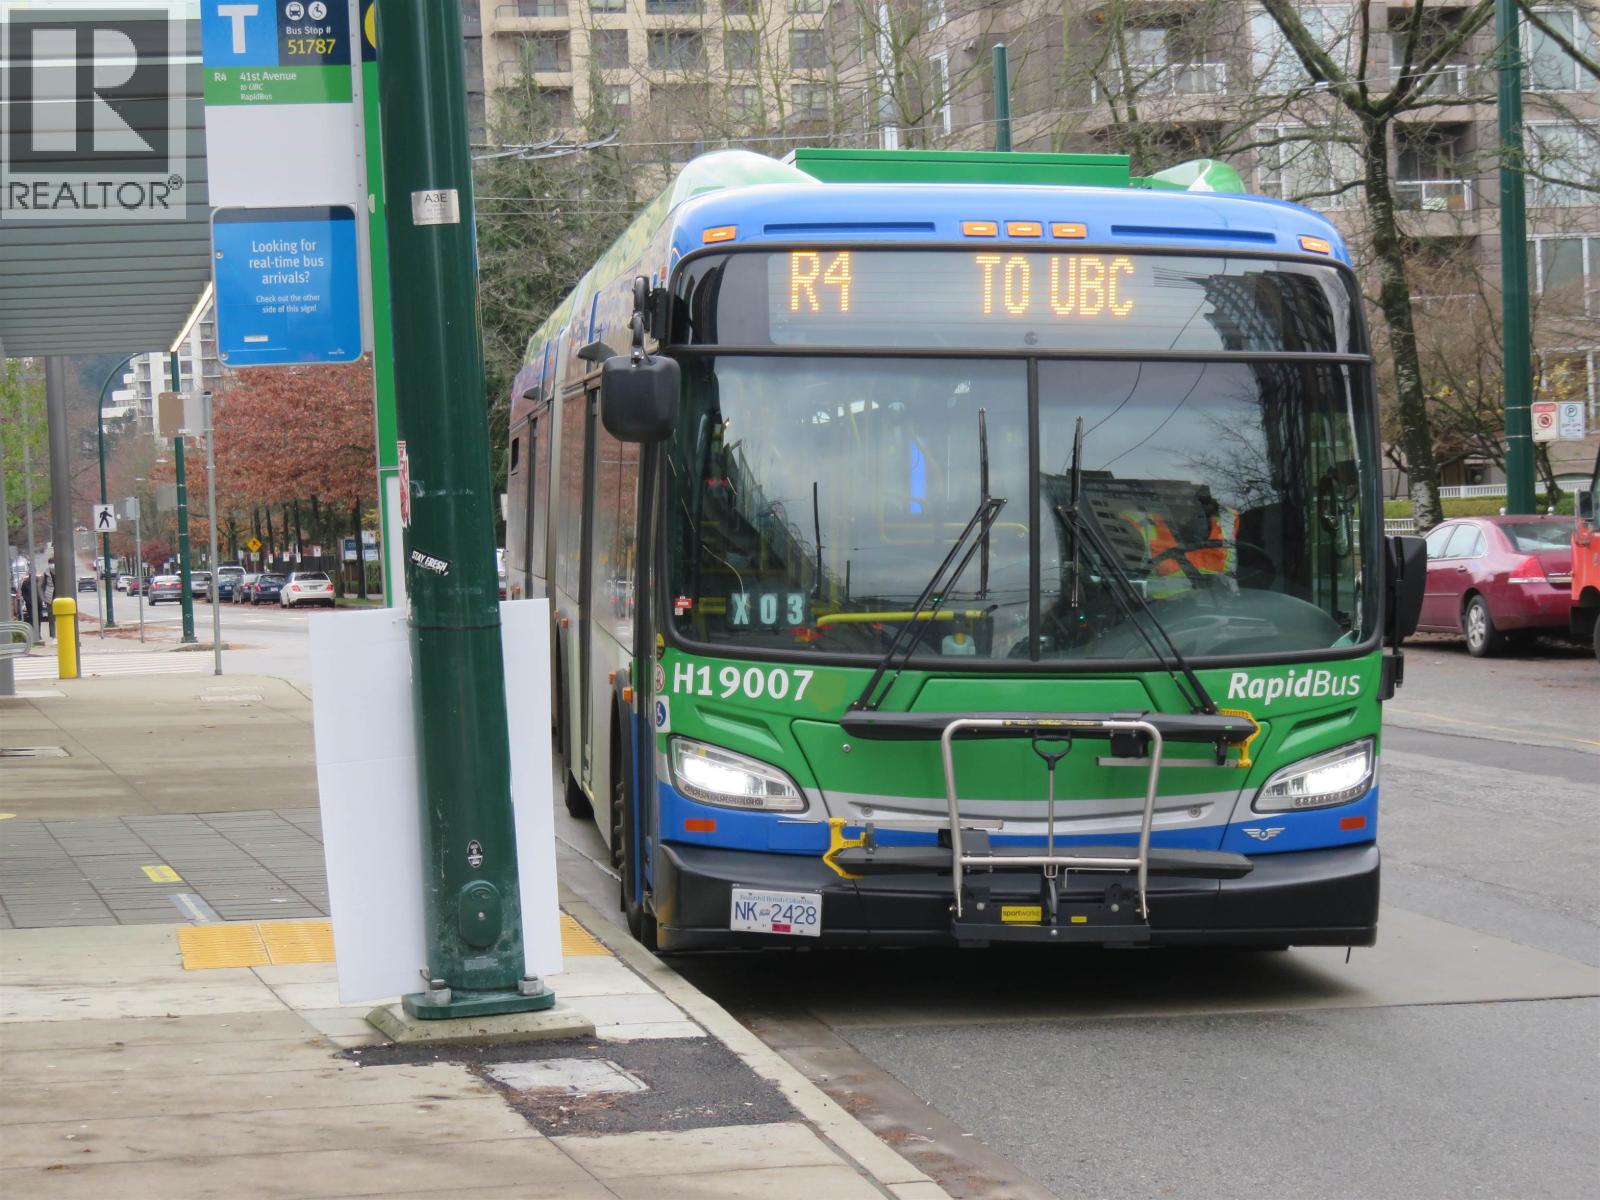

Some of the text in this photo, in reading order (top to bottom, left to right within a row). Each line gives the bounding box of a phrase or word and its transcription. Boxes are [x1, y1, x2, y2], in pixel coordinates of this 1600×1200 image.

[217, 4, 259, 54] T
[286, 26, 332, 37] Bus Stop #
[287, 39, 336, 54] 51787
[214, 71, 297, 82] R4 41st Avenue
[240, 93, 273, 101] RapidBus
[424, 193, 448, 203] A3E
[252, 239, 316, 254] Looking for
[249, 255, 324, 269] real-time bus
[262, 271, 310, 285] arrivals?
[790, 251, 1135, 317] R4 TO UBC
[256, 294, 320, 303] Check out the other
[262, 305, 276, 313] side
[277, 305, 285, 313] of
[300, 304, 317, 314] sign!
[412, 551, 447, 572] STAY FRESH
[673, 662, 814, 701] H19007
[1227, 669, 1361, 706] RapidBus
[735, 901, 817, 926] NK 2428
